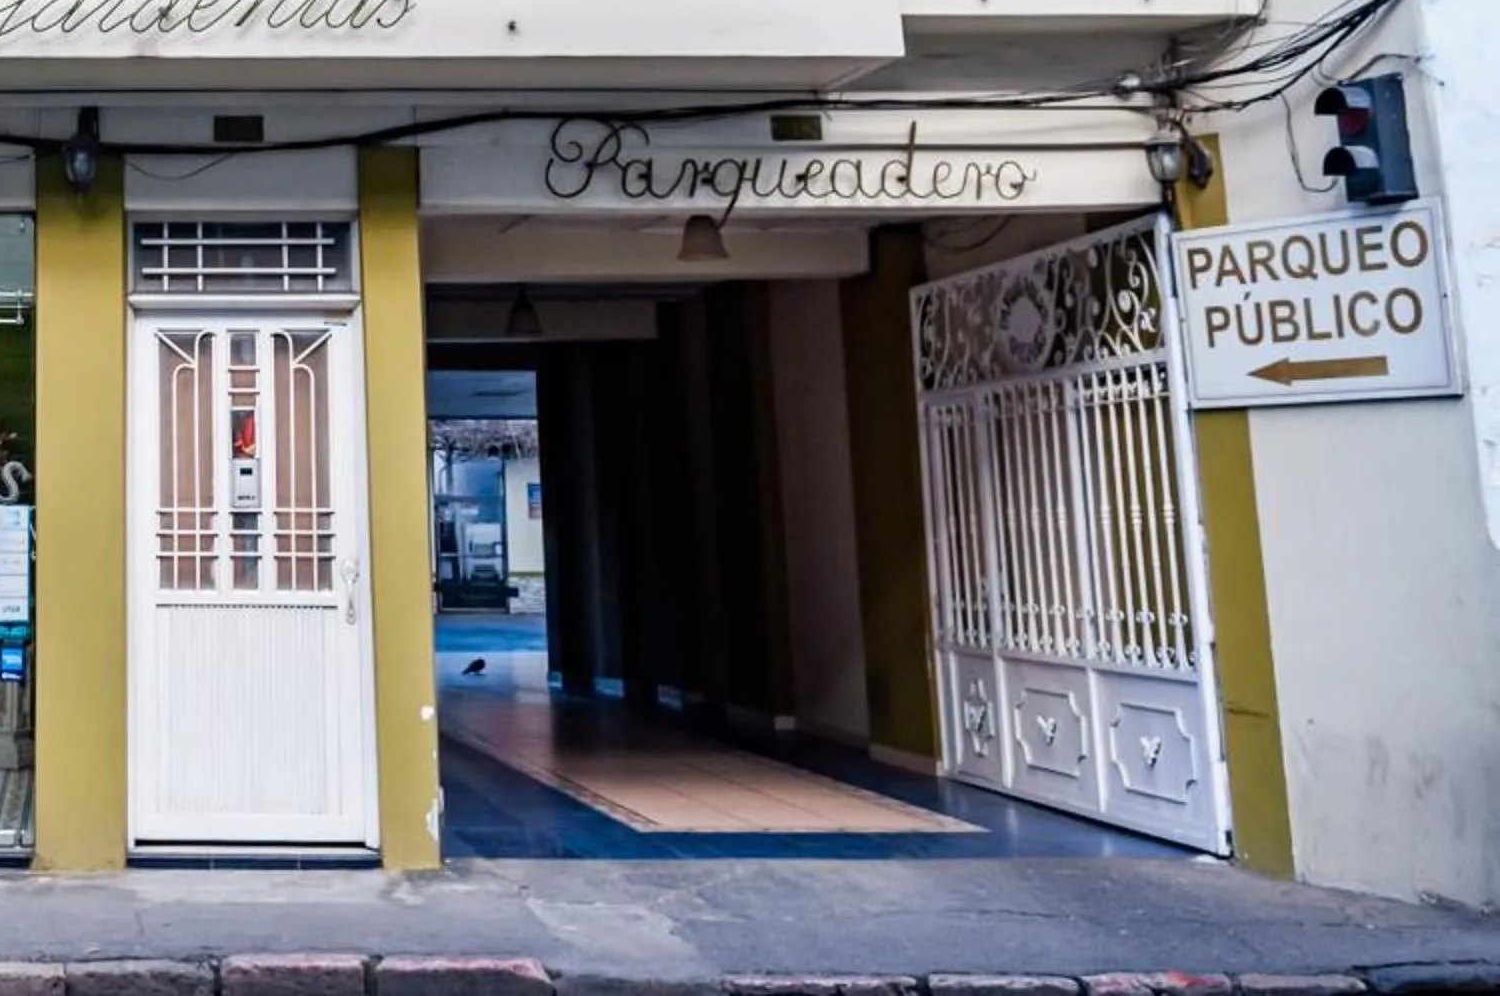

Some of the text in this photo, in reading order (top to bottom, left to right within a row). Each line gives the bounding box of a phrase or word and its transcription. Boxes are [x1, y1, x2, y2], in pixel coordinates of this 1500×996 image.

[546, 115, 1037, 228] Parqueadero
[1187, 221, 1428, 290] PARQUEO
[1205, 287, 1422, 348] PÚBLICO
